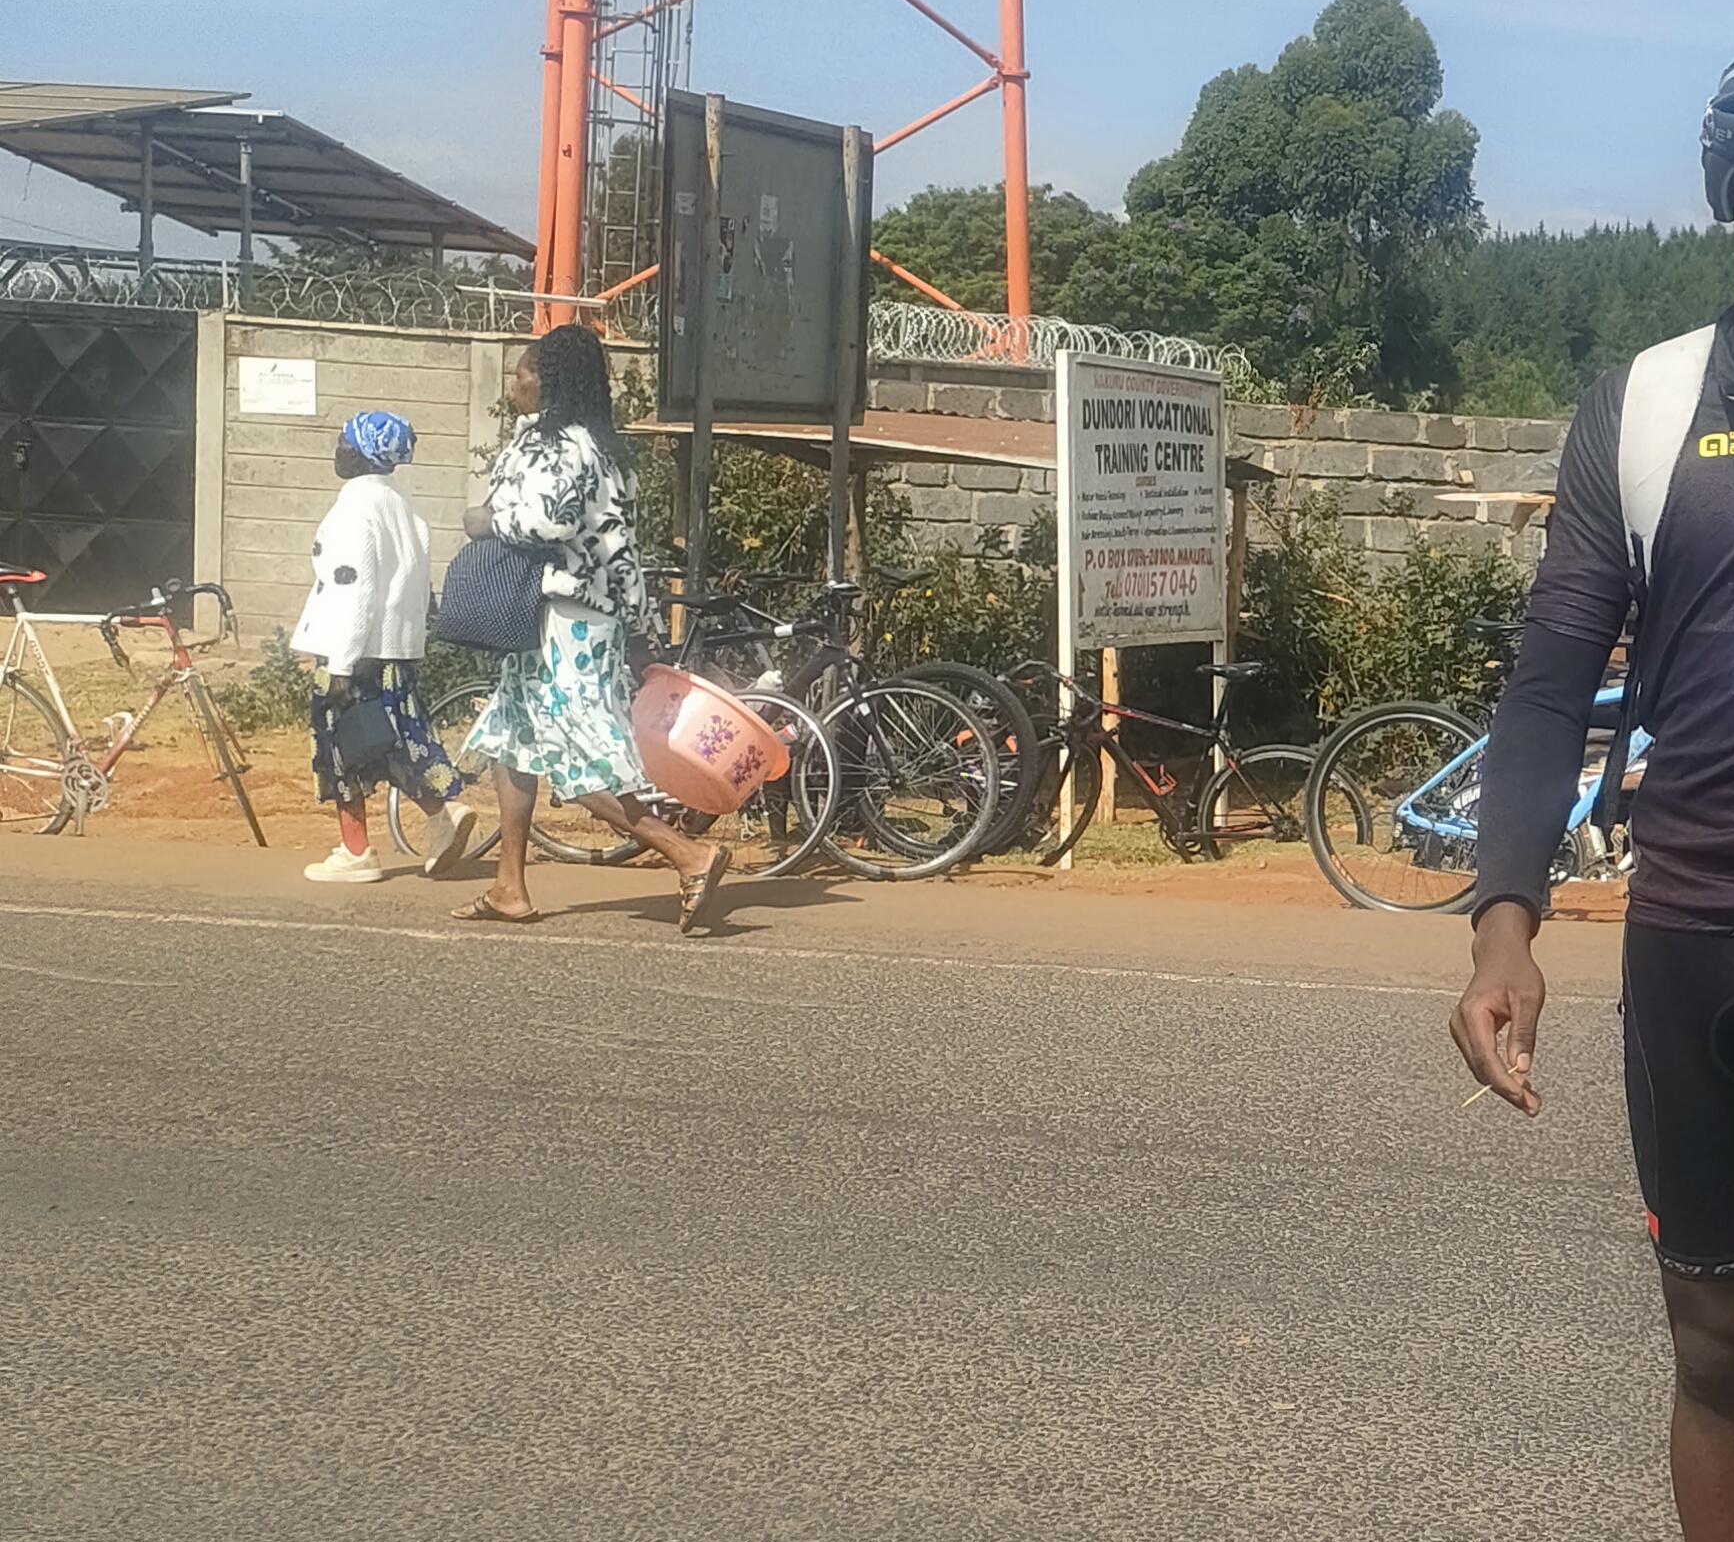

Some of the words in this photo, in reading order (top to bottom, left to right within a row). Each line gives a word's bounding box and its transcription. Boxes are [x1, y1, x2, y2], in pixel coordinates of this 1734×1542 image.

[1082, 399, 1136, 430] DUNDORI
[1139, 399, 1214, 437] VOCATIONAL
[1094, 442, 1149, 475] TRAINING
[1155, 441, 1204, 473] CENTRE
